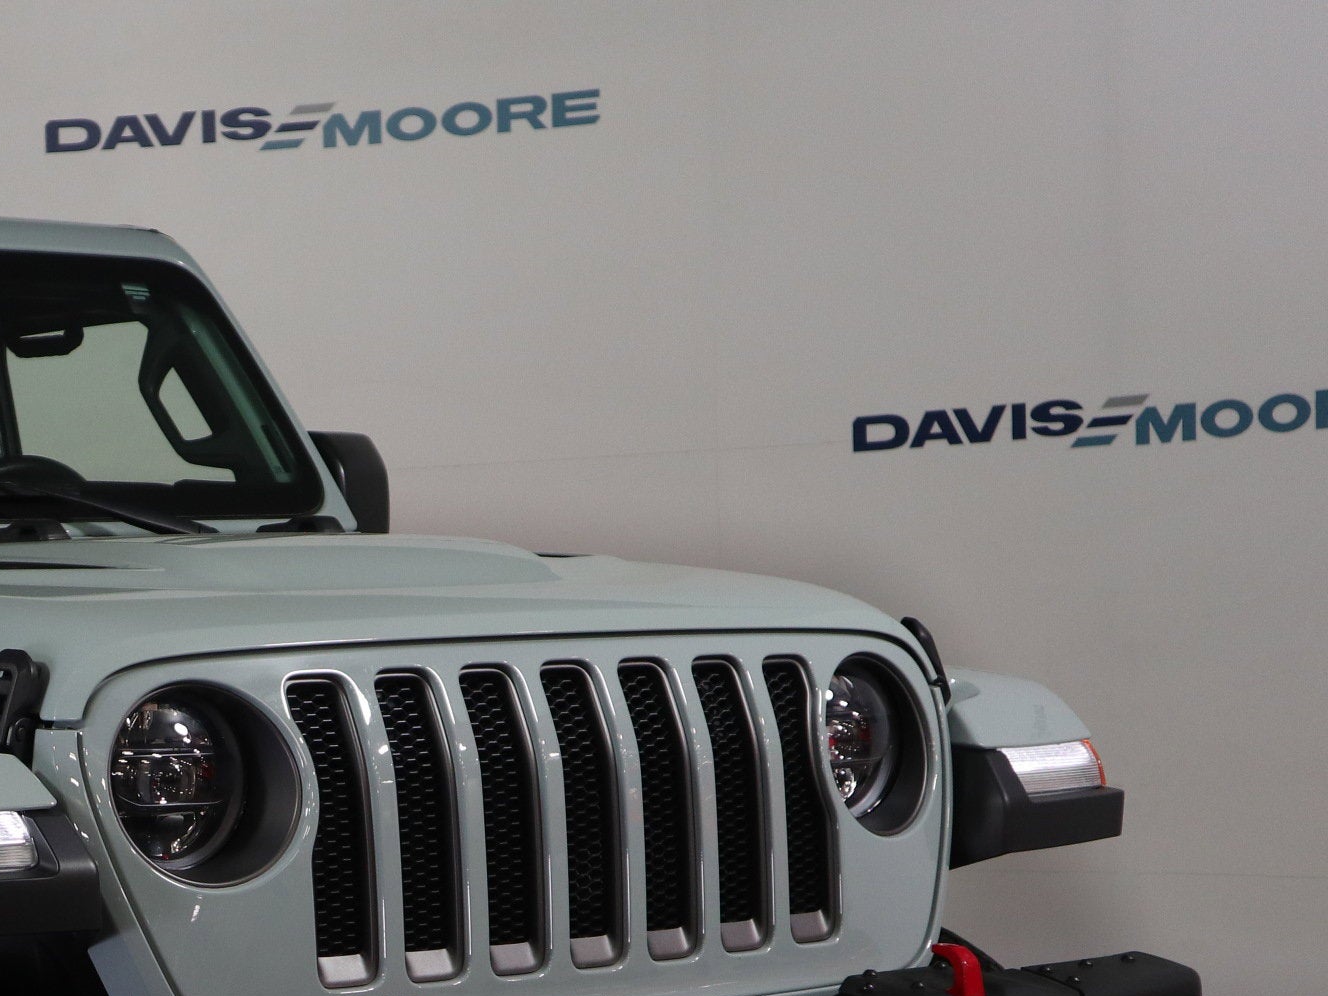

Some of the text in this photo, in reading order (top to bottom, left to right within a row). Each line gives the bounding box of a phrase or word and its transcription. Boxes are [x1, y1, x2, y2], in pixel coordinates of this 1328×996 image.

[45, 88, 601, 153] DAVIS MOORE
[852, 389, 1328, 453] DAVIS MOO
